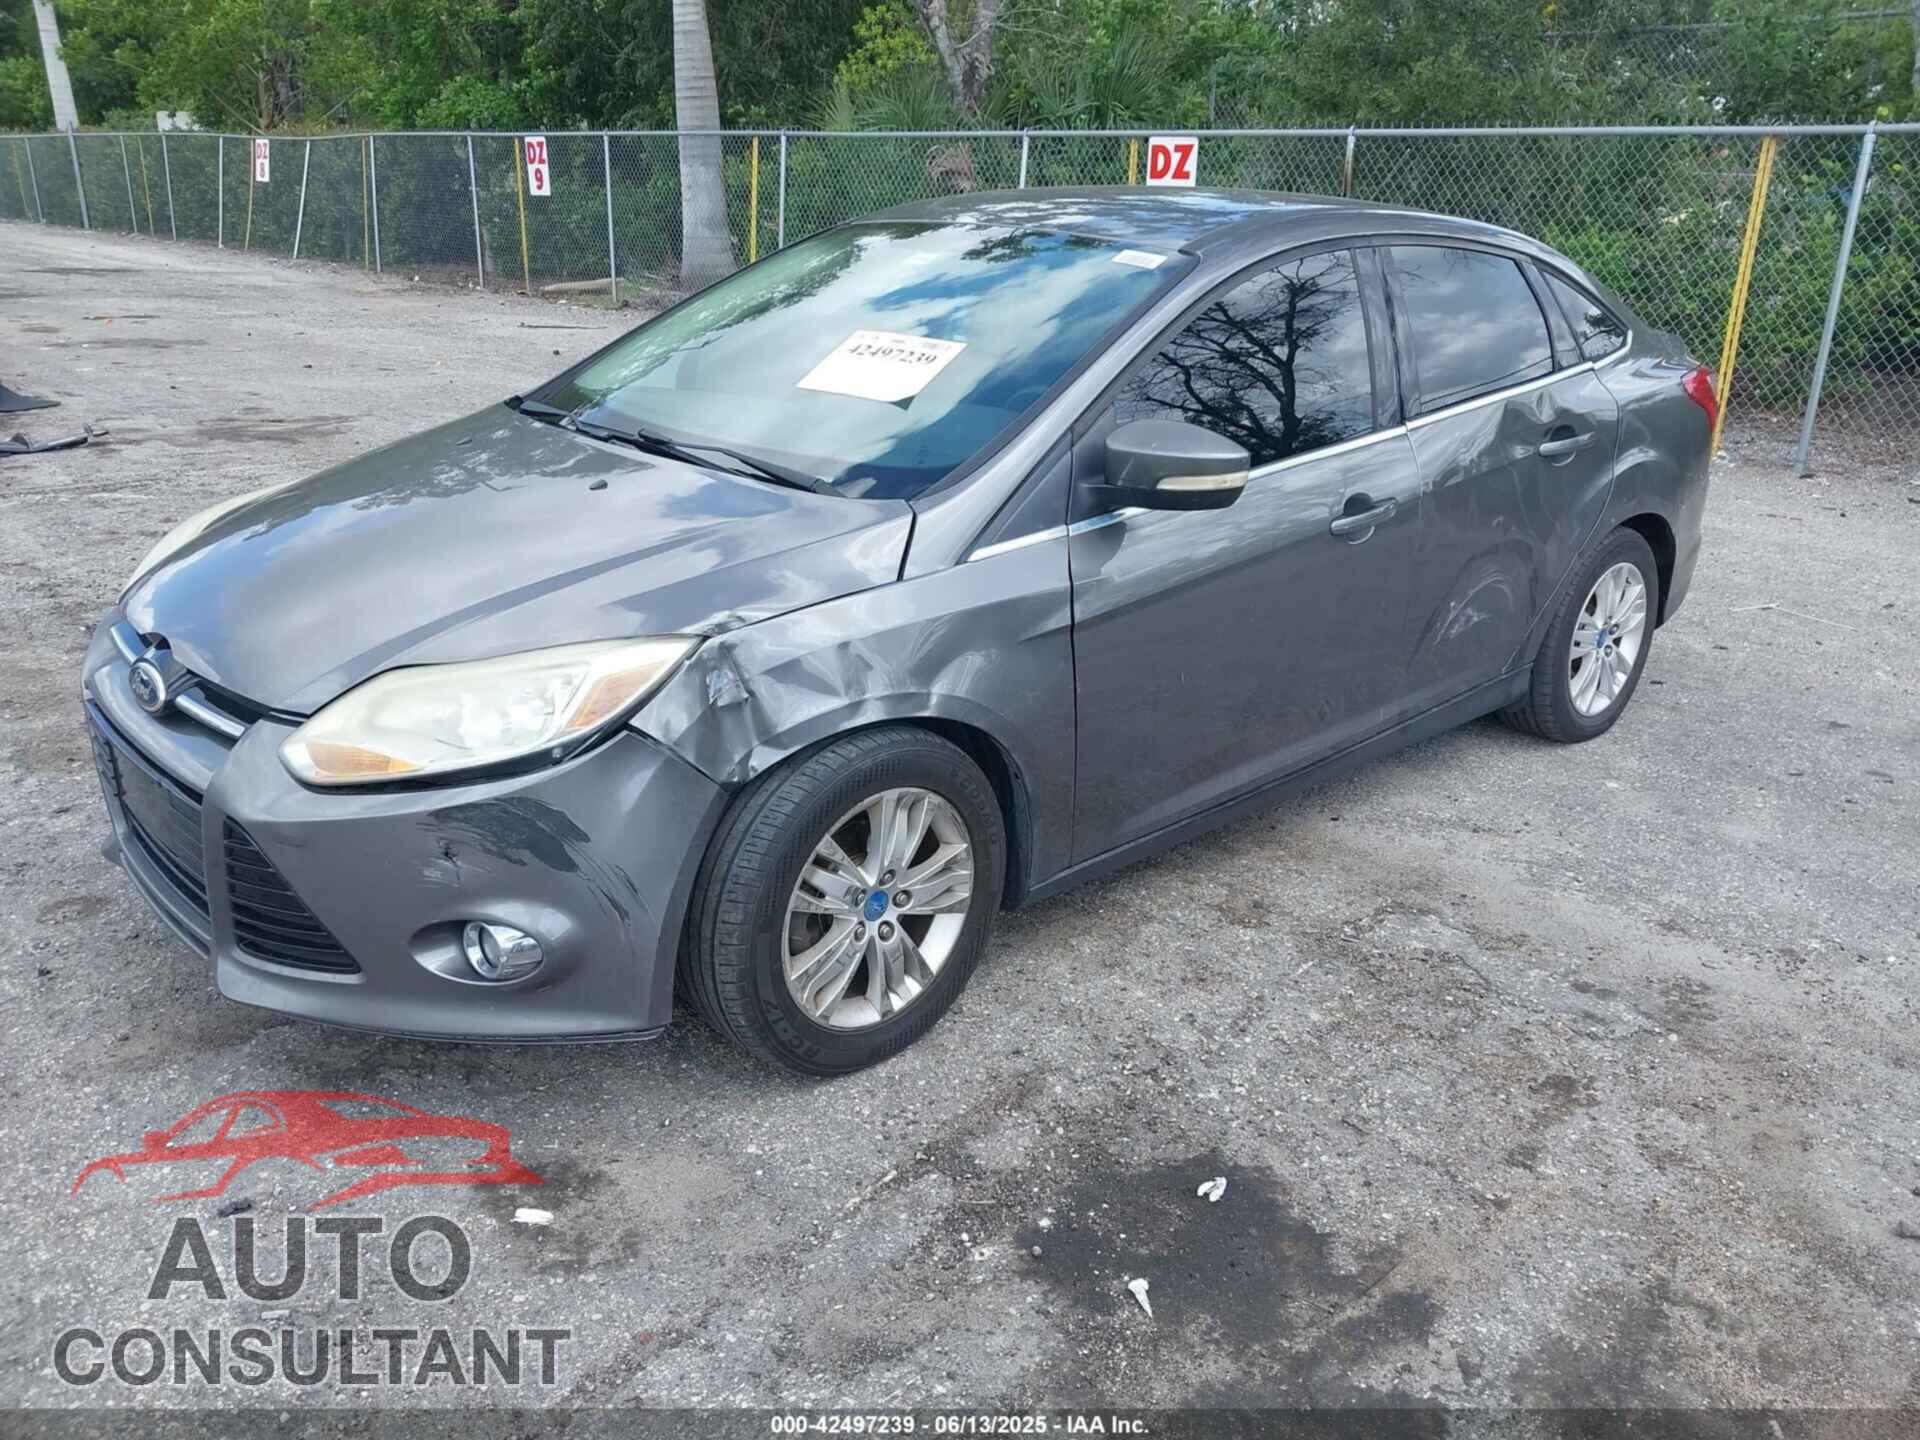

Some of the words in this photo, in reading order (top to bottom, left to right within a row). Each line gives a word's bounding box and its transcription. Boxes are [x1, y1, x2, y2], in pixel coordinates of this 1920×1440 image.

[527, 141, 545, 165] DZ
[1150, 144, 1195, 179] DZ
[534, 168, 544, 190] 9
[848, 343, 938, 364] 42497239
